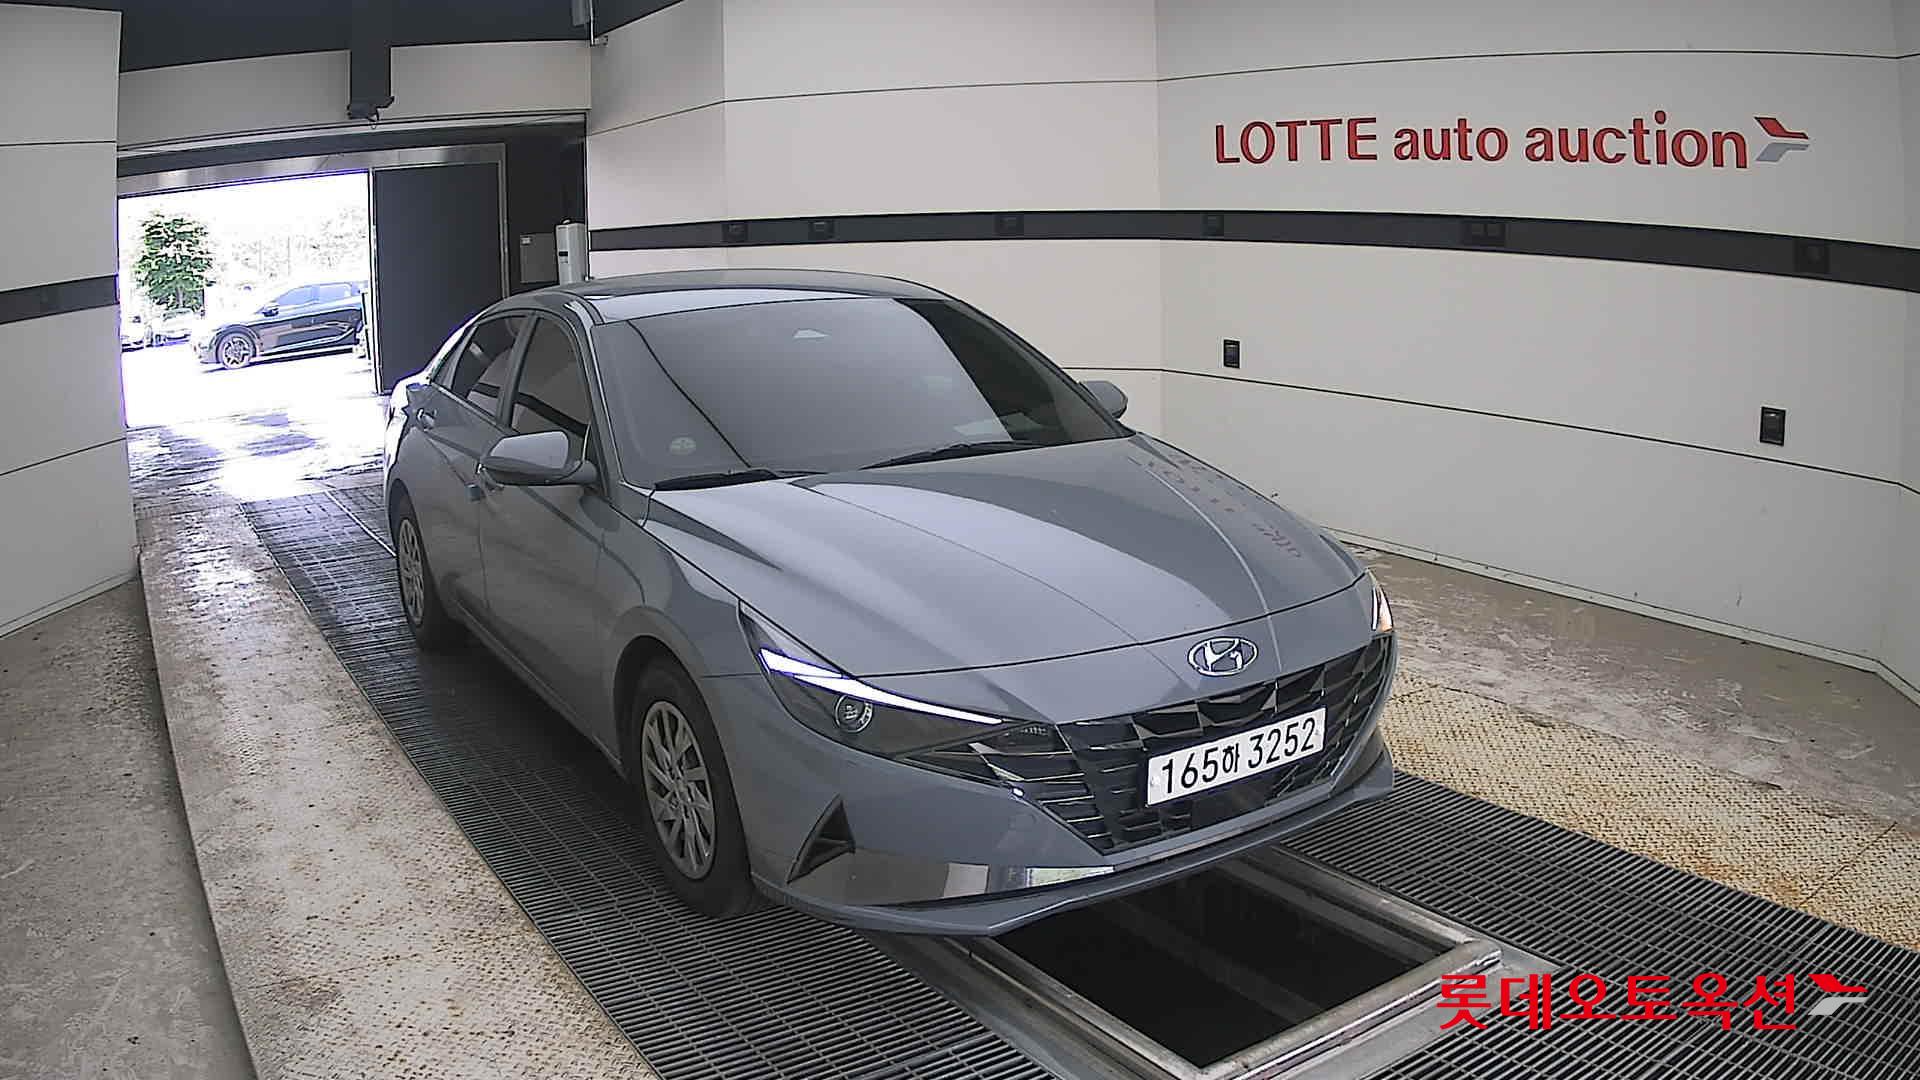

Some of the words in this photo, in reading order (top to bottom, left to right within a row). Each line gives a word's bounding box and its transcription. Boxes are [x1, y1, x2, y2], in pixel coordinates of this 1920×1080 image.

[1214, 116, 1377, 164] LOTTE
[1393, 117, 1509, 162] auto
[1524, 110, 1748, 169] auction
[1161, 742, 1240, 794] 165하
[1247, 717, 1316, 769] 3252
